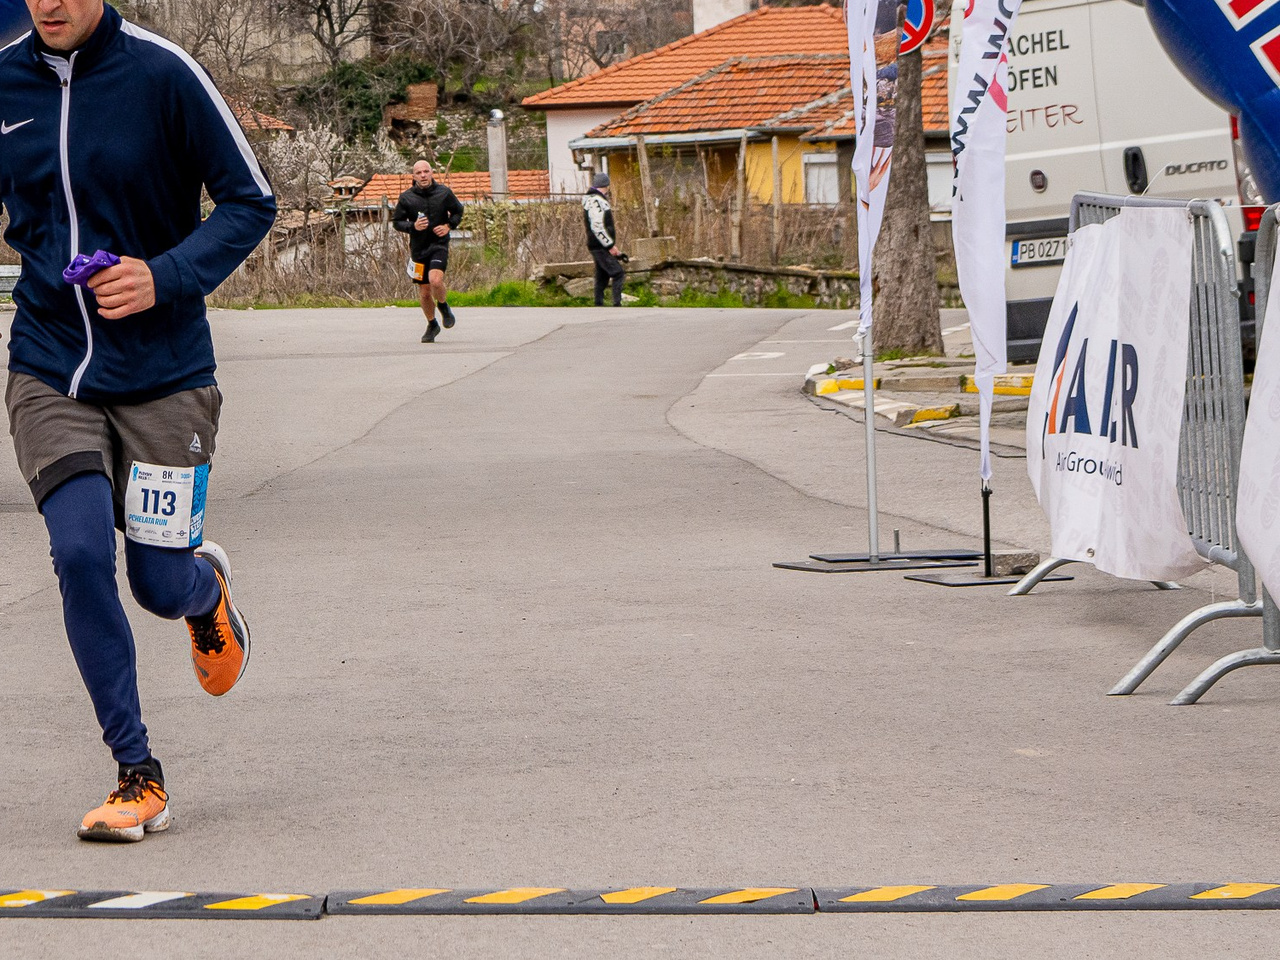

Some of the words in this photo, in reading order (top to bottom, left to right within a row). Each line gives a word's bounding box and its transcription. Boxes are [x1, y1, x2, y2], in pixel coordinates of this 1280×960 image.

[1007, 29, 1070, 57] ACHEL
[1006, 103, 1084, 133] EITER
[1165, 159, 1228, 177] DUCATO
[162, 470, 174, 480] 8K
[141, 487, 177, 517] 113
